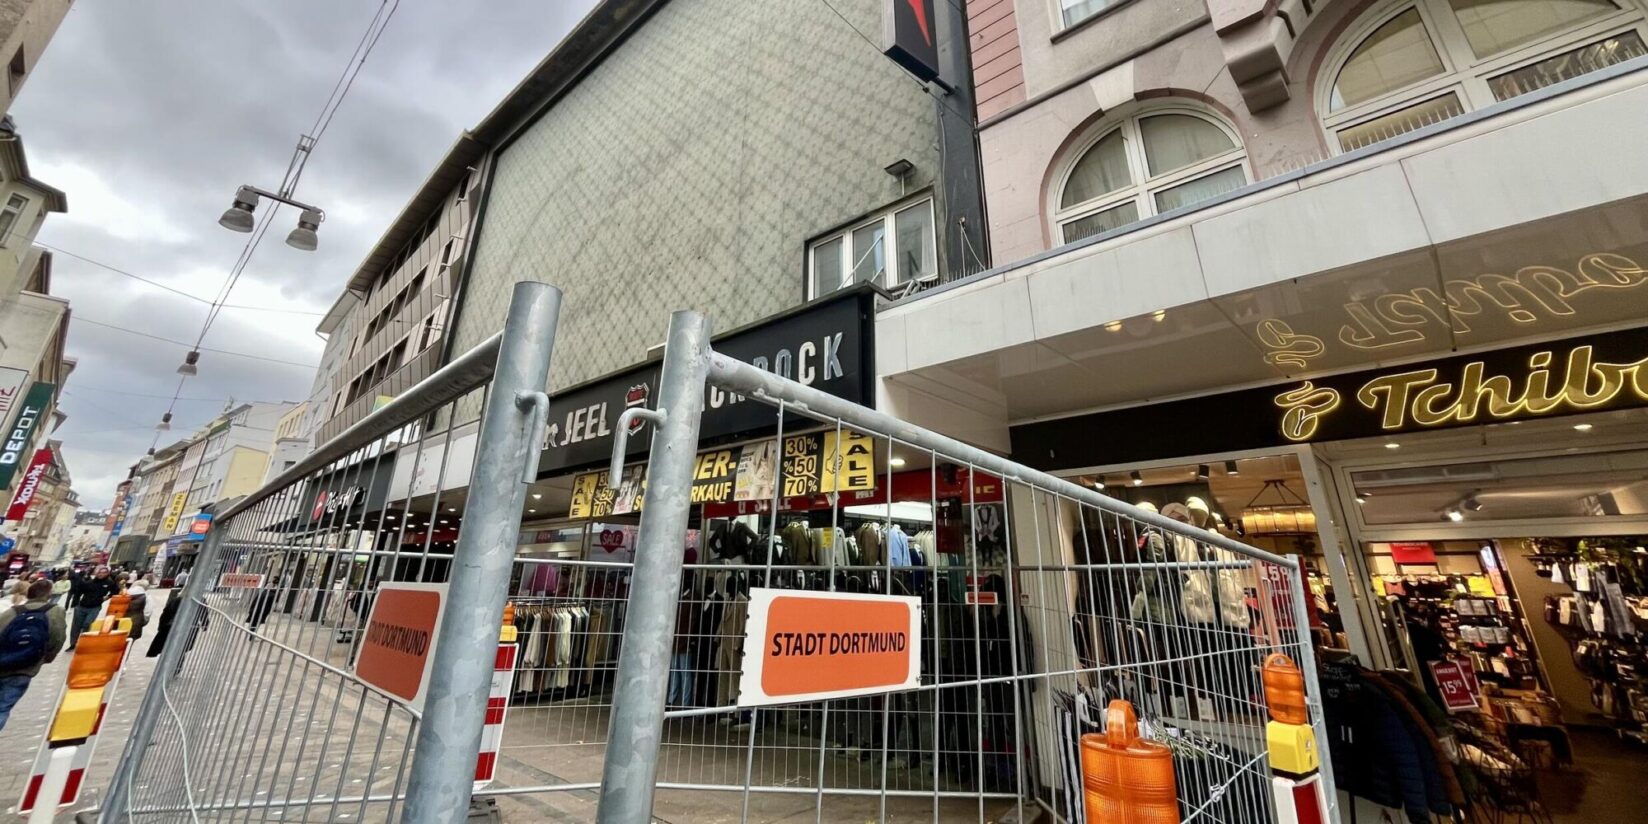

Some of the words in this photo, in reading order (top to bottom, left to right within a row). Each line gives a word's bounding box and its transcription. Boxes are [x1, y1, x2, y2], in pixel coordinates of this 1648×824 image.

[0, 406, 39, 464] DEPOT
[560, 402, 611, 446] JEEL
[571, 476, 586, 516] SALE
[380, 623, 428, 656] DORTMUND
[771, 632, 826, 656] STADT
[829, 632, 905, 655] DORTMUND
